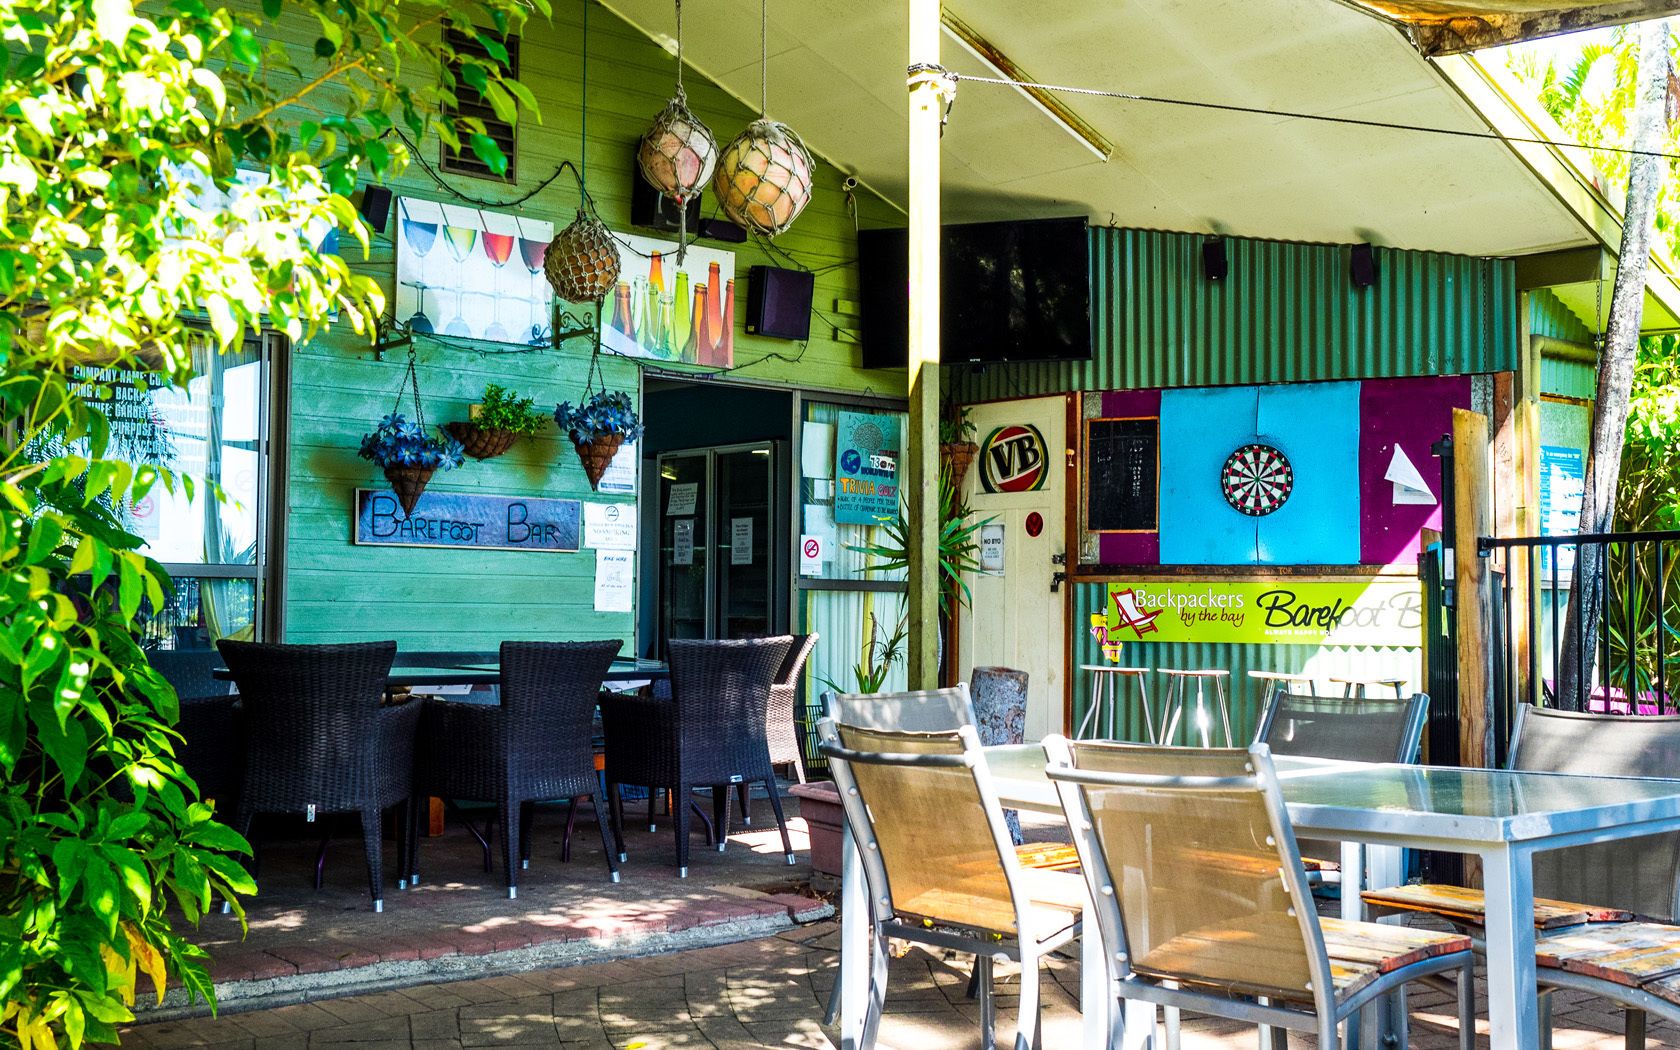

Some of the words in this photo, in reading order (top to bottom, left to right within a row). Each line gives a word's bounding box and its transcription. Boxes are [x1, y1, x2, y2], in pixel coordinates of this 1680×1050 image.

[989, 433, 1042, 481] VB
[840, 477, 876, 496] TRIVIA
[877, 483, 897, 497] QUIZ
[1135, 588, 1244, 615] Backpackers
[1256, 590, 1386, 637] Barefoot
[1180, 608, 1196, 627] by
[1198, 608, 1219, 622] the
[1221, 608, 1244, 628] bay
